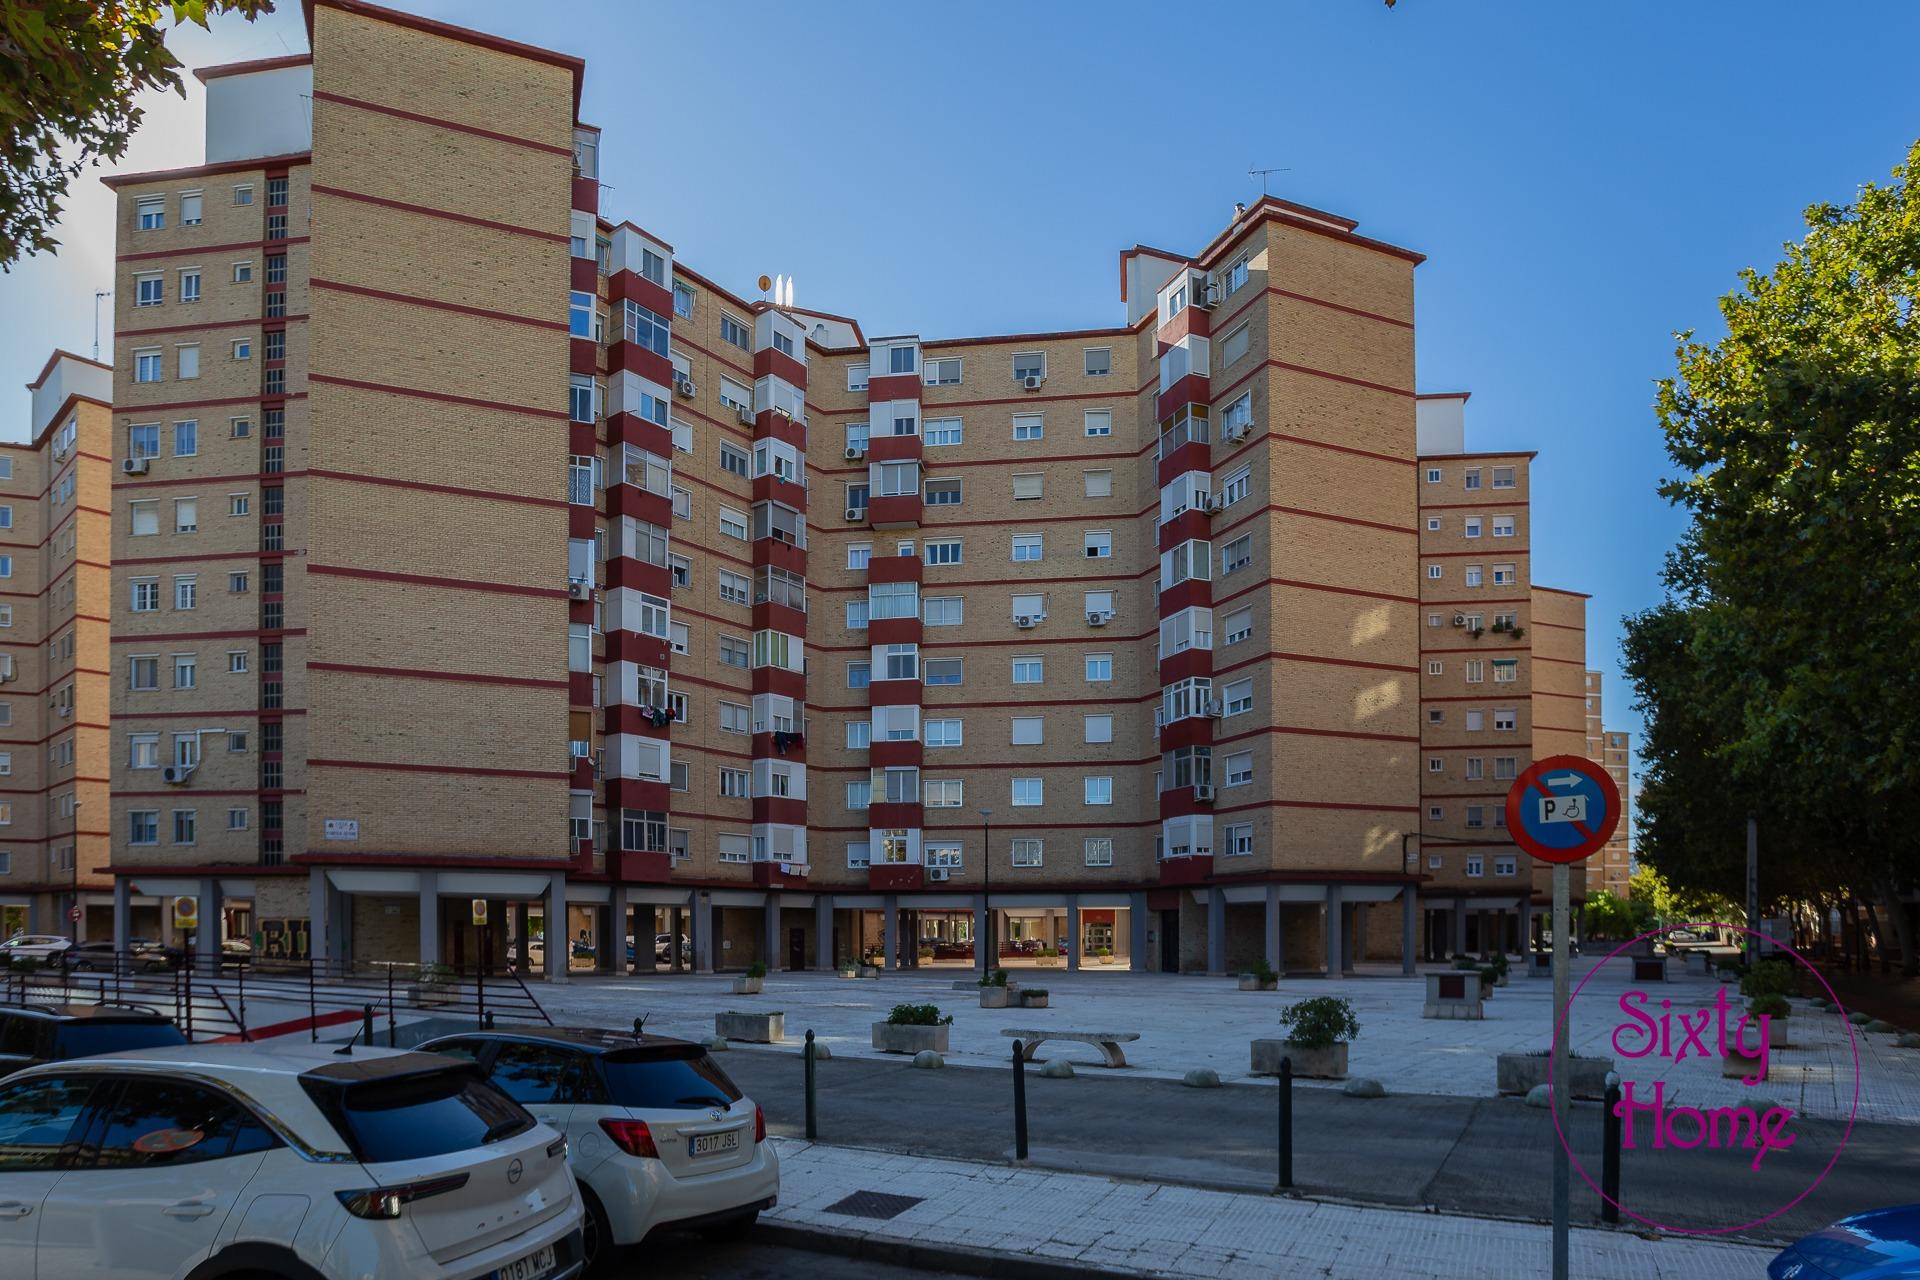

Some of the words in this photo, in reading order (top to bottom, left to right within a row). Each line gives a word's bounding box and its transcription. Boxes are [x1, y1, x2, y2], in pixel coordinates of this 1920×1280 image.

[1544, 800, 1556, 821] P
[696, 1135, 719, 1152] 3017
[722, 1133, 737, 1148] JSL
[501, 1256, 530, 1280] 0181
[532, 1246, 554, 1273] MCJ
